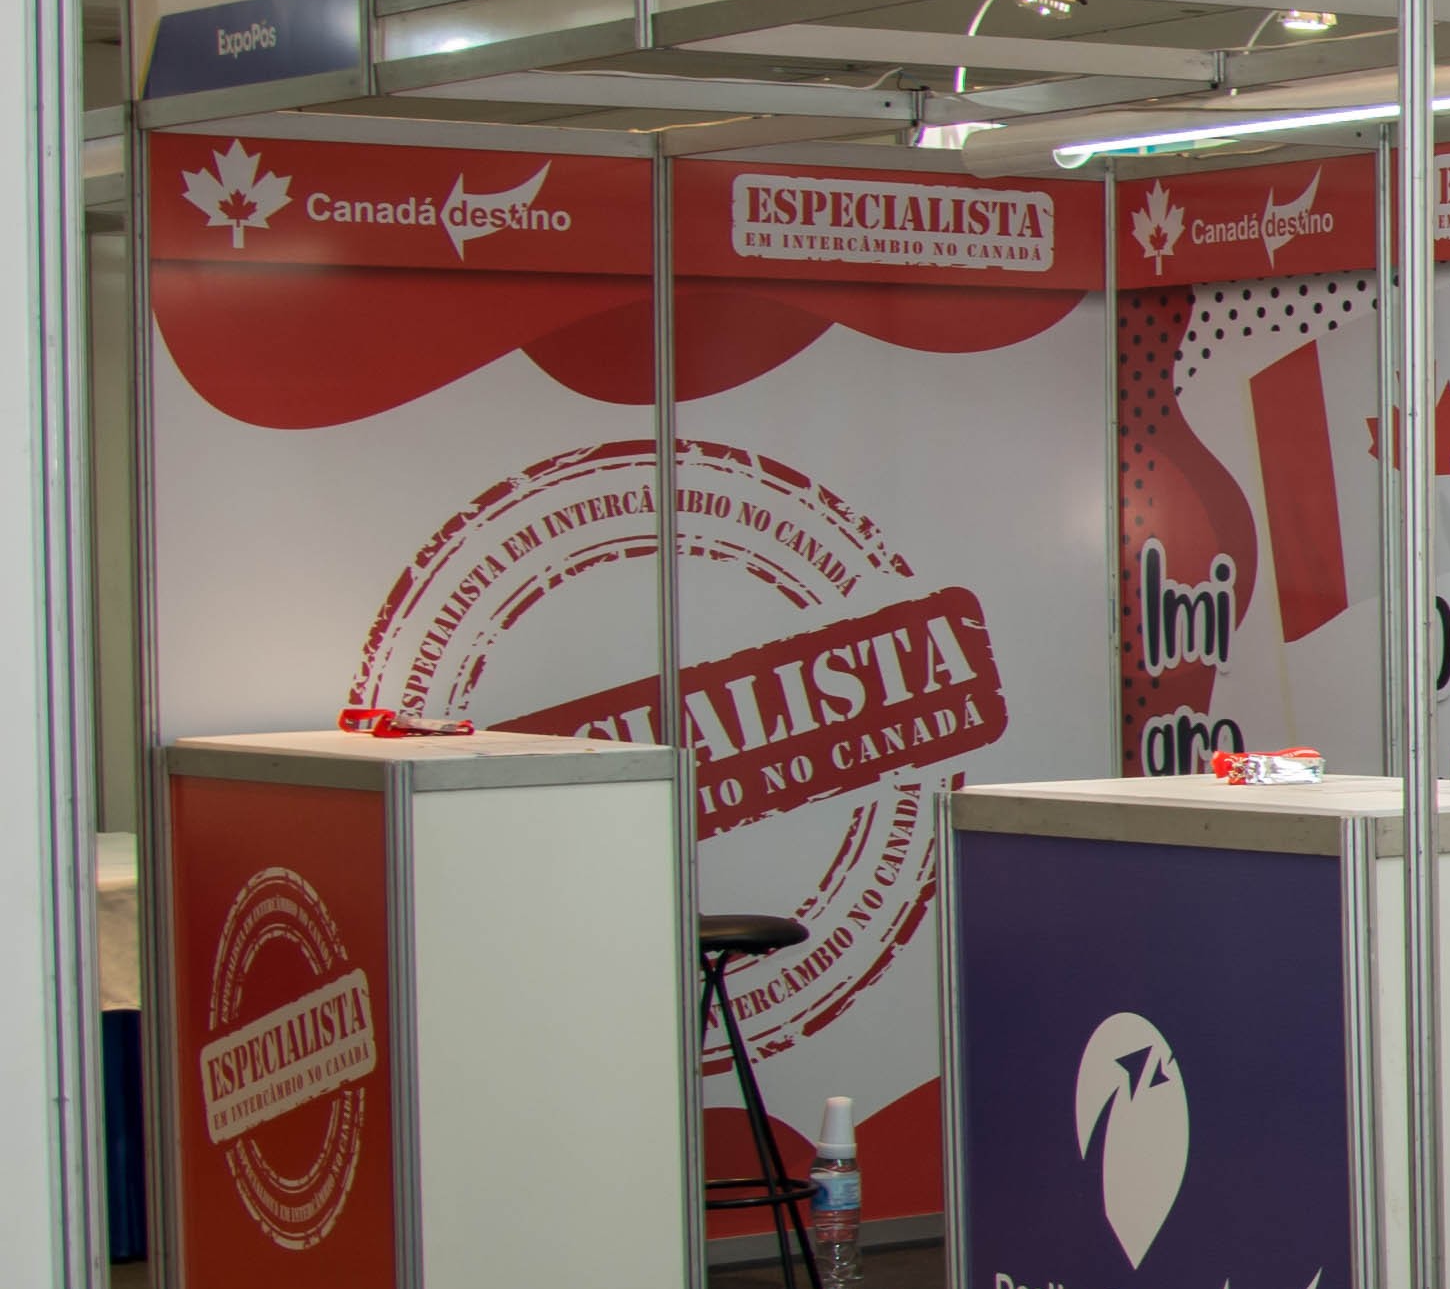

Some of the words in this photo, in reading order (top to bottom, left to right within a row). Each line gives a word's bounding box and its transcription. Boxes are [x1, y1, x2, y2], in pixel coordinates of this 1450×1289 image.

[217, 19, 276, 59] ExpoPós
[306, 191, 437, 229] Canadá
[448, 200, 572, 232] destino
[746, 186, 1044, 238] ESPECIALISTA
[1191, 212, 1258, 245] Canadá
[1264, 204, 1334, 241] destino
[746, 232, 771, 247] EM
[783, 233, 923, 255] INTERCÂMBIO
[934, 242, 957, 256] NO
[967, 244, 1041, 261] CANADÁ
[502, 524, 543, 562] EM
[541, 485, 731, 539] INTERCÂBIO
[736, 501, 771, 532] NO
[775, 521, 862, 598] CANADÁ
[761, 755, 813, 794] NO
[831, 694, 984, 771] CANADÁ
[847, 889, 884, 930] NO
[874, 773, 922, 887] CANADÁ
[208, 987, 366, 1102] ESPECIALISTA
